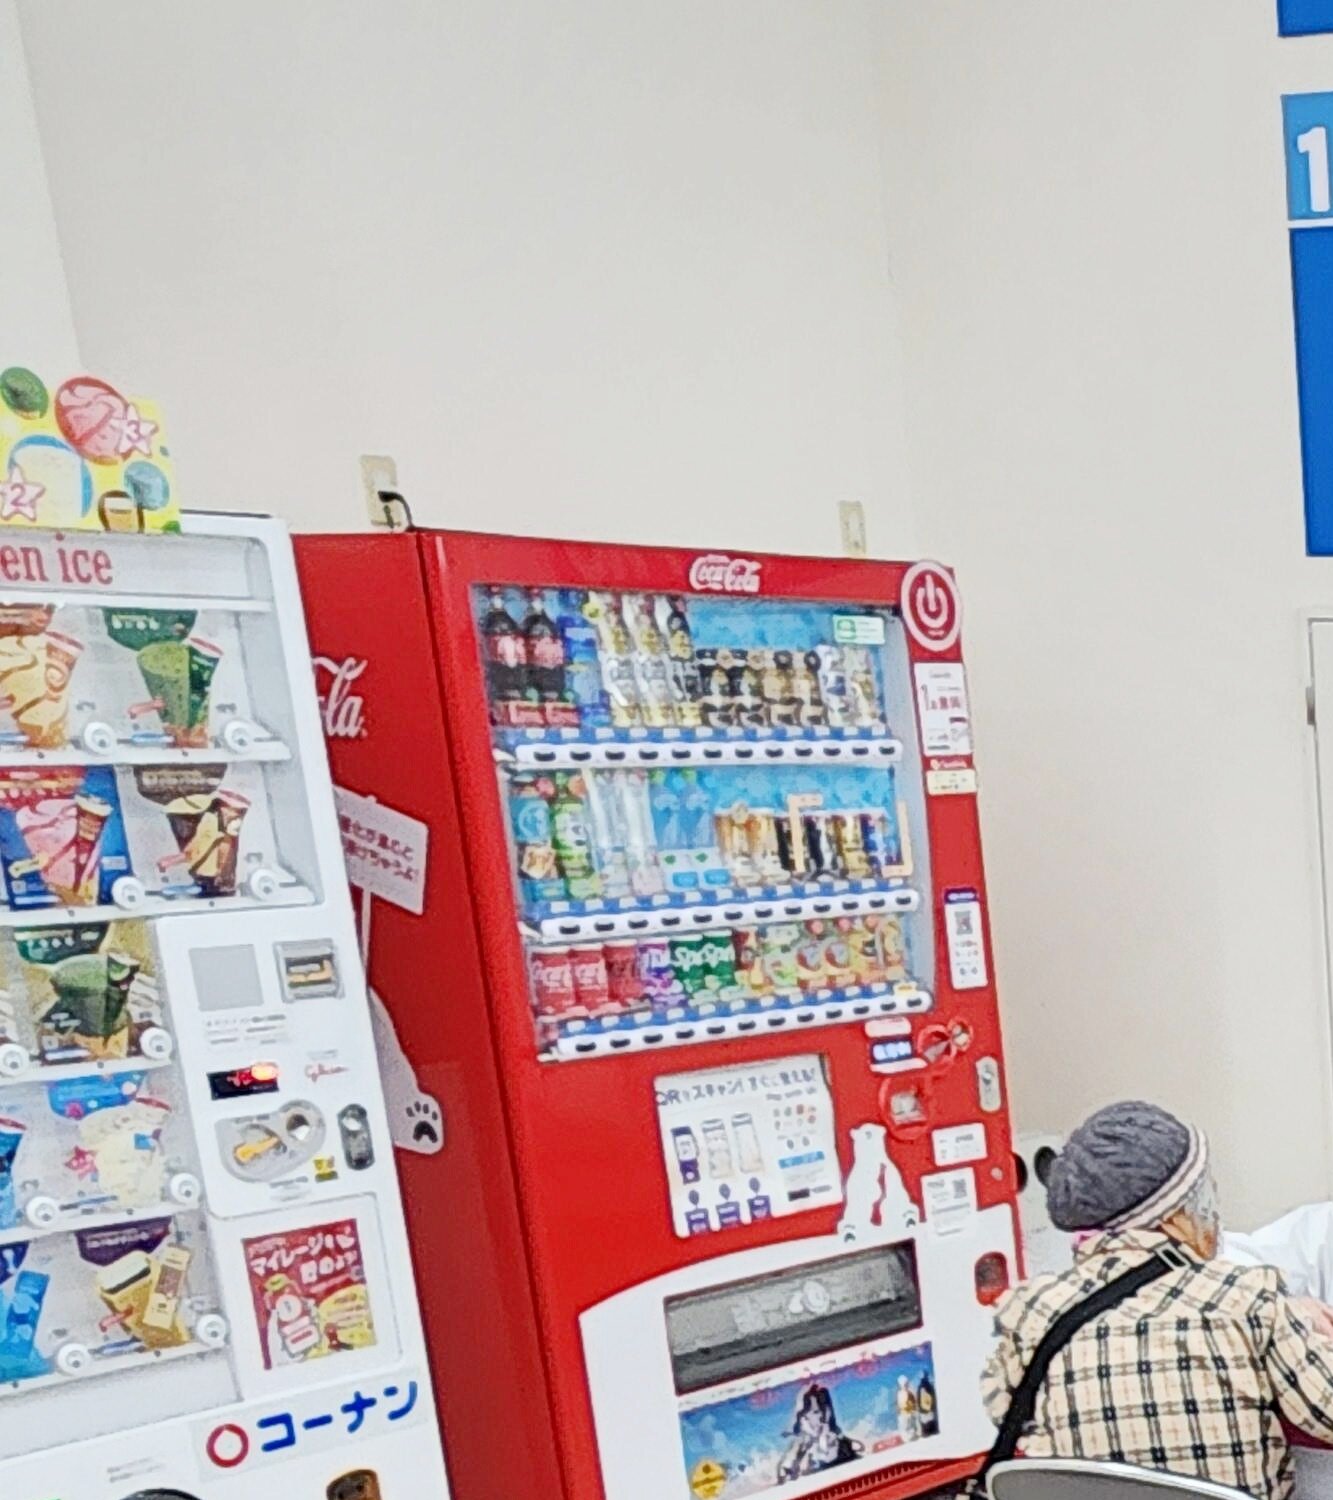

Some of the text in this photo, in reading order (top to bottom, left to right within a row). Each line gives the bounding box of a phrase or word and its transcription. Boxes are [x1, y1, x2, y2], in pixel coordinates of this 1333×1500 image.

[55, 532, 114, 585] ice
[257, 1380, 420, 1453] コーナン
